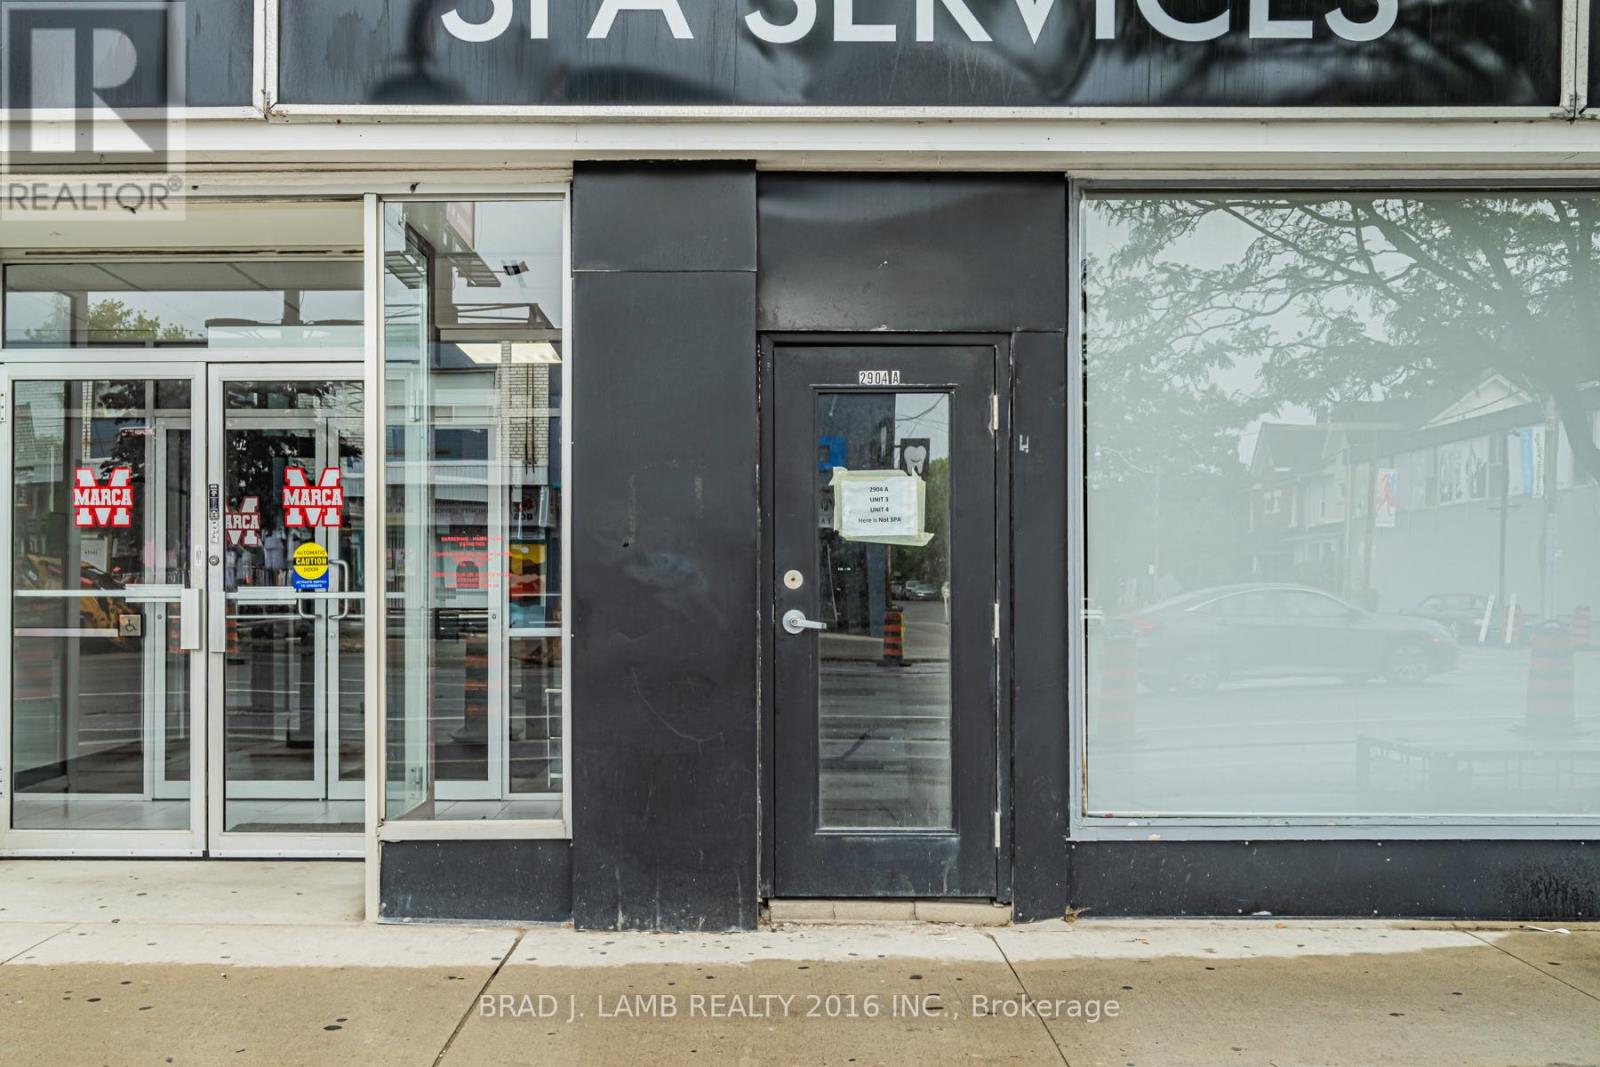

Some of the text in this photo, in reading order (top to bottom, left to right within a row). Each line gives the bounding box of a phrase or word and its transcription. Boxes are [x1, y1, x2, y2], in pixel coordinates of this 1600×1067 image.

[860, 371, 899, 385] 2904 A
[73, 488, 132, 506] MARCA
[282, 488, 343, 506] MARCA
[224, 514, 260, 529] ARCA
